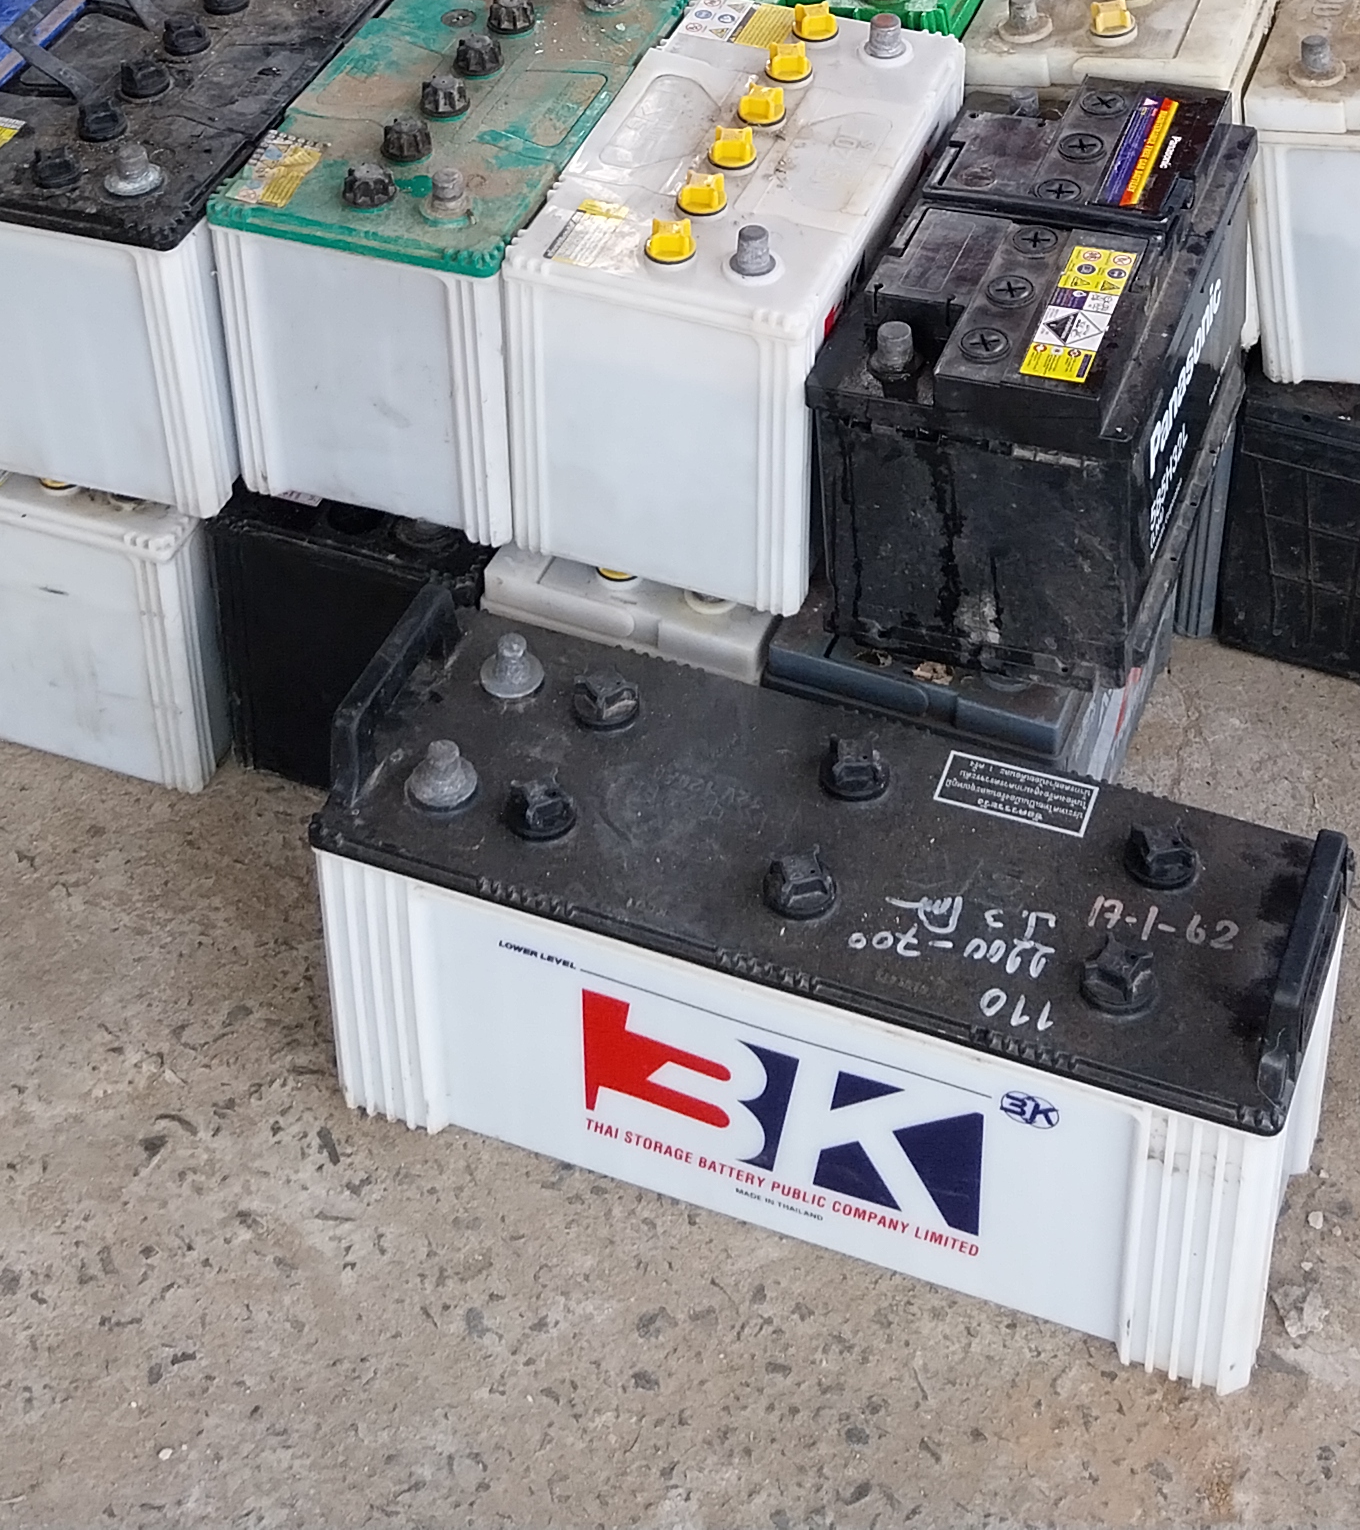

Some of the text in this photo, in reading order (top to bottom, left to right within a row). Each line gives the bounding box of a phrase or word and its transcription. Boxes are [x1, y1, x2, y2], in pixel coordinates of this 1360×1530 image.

[1158, 136, 1183, 170] Panasonic
[1149, 278, 1222, 479] Panasonic
[1087, 895, 1239, 951] 17-1-62
[498, 939, 577, 970] LOWER LEVEL
[980, 988, 1055, 1032] 110
[1002, 1091, 1059, 1128] 3K
[585, 1118, 981, 1258] THAI STORAGE BATTERY PUBLIC COMPANY LIMITED
[734, 1186, 765, 1202] MADE
[776, 1198, 825, 1222] THAILAND
